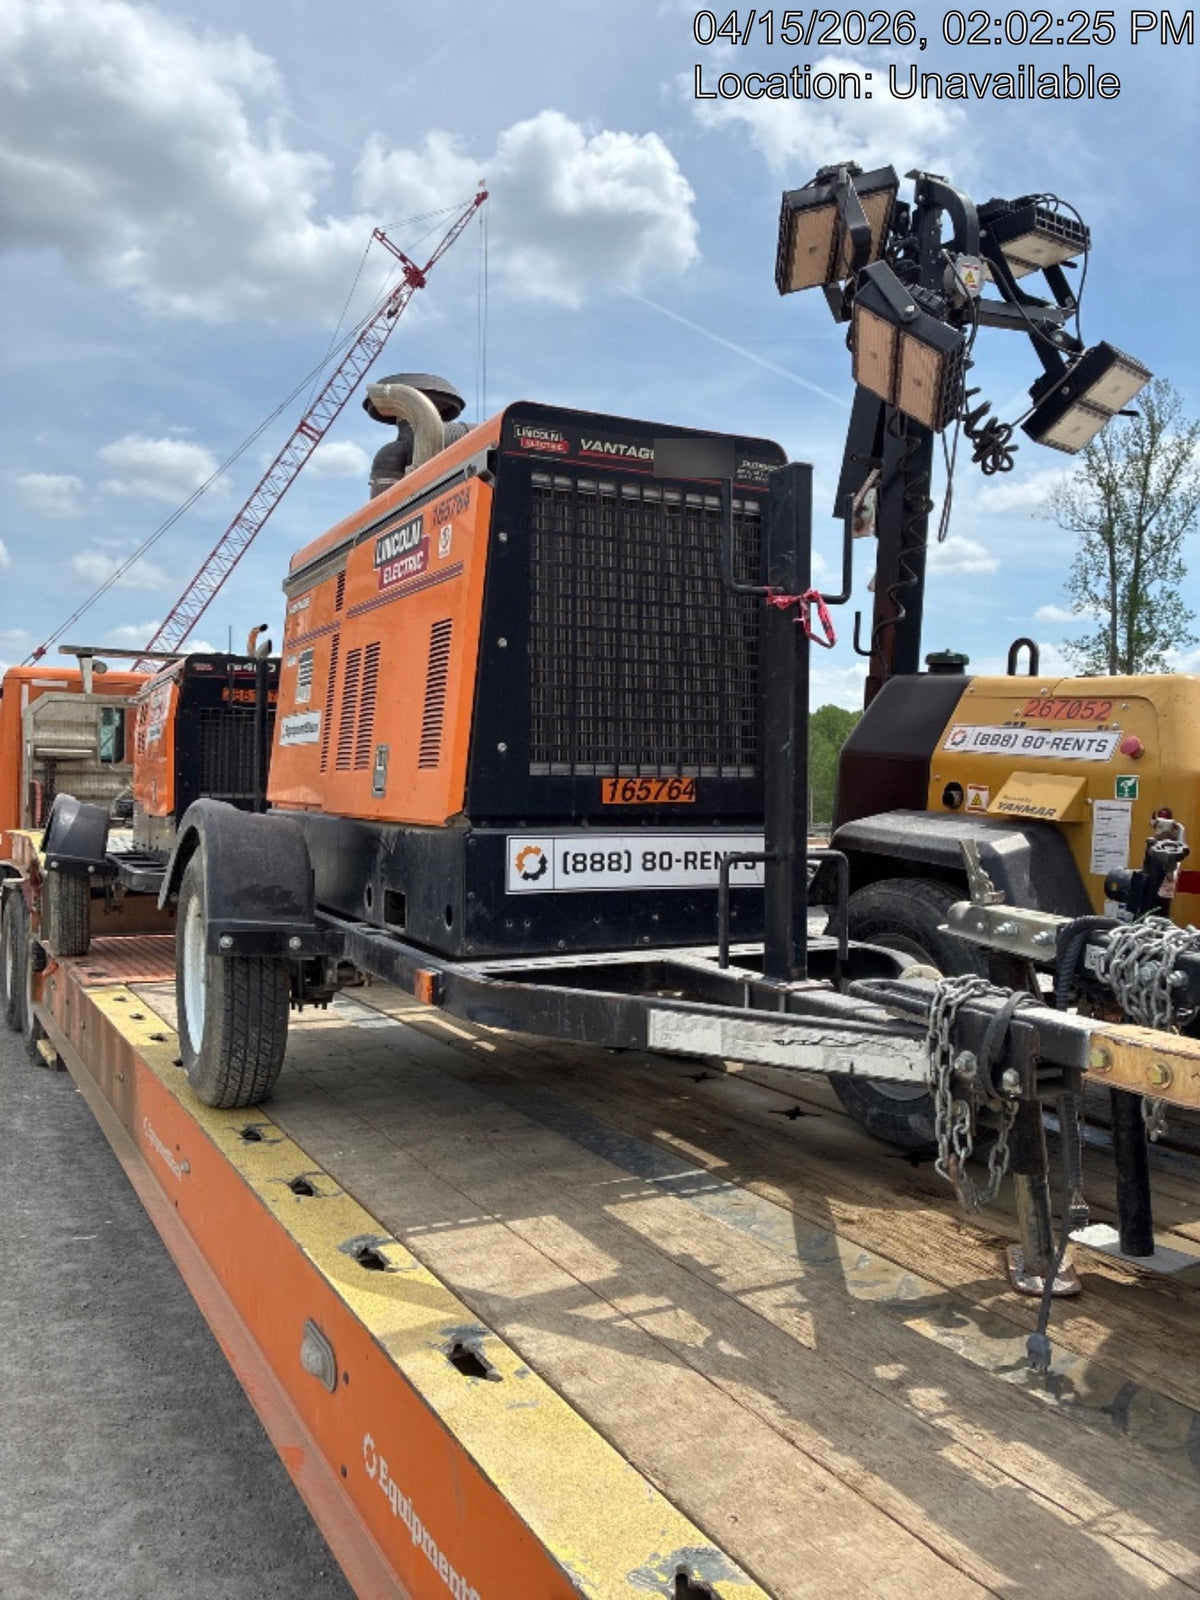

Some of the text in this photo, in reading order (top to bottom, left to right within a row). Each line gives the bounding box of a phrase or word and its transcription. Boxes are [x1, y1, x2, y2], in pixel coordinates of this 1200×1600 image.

[516, 427, 560, 442] LINCOLN
[376, 520, 421, 564] LINCOLN
[383, 551, 424, 584] ELECTRIC
[1024, 700, 1112, 721] 267052
[973, 732, 1109, 753] (888) 80-RENTS
[608, 778, 696, 801] 165764
[997, 801, 1057, 817] YANMAR
[562, 851, 632, 875] (888)
